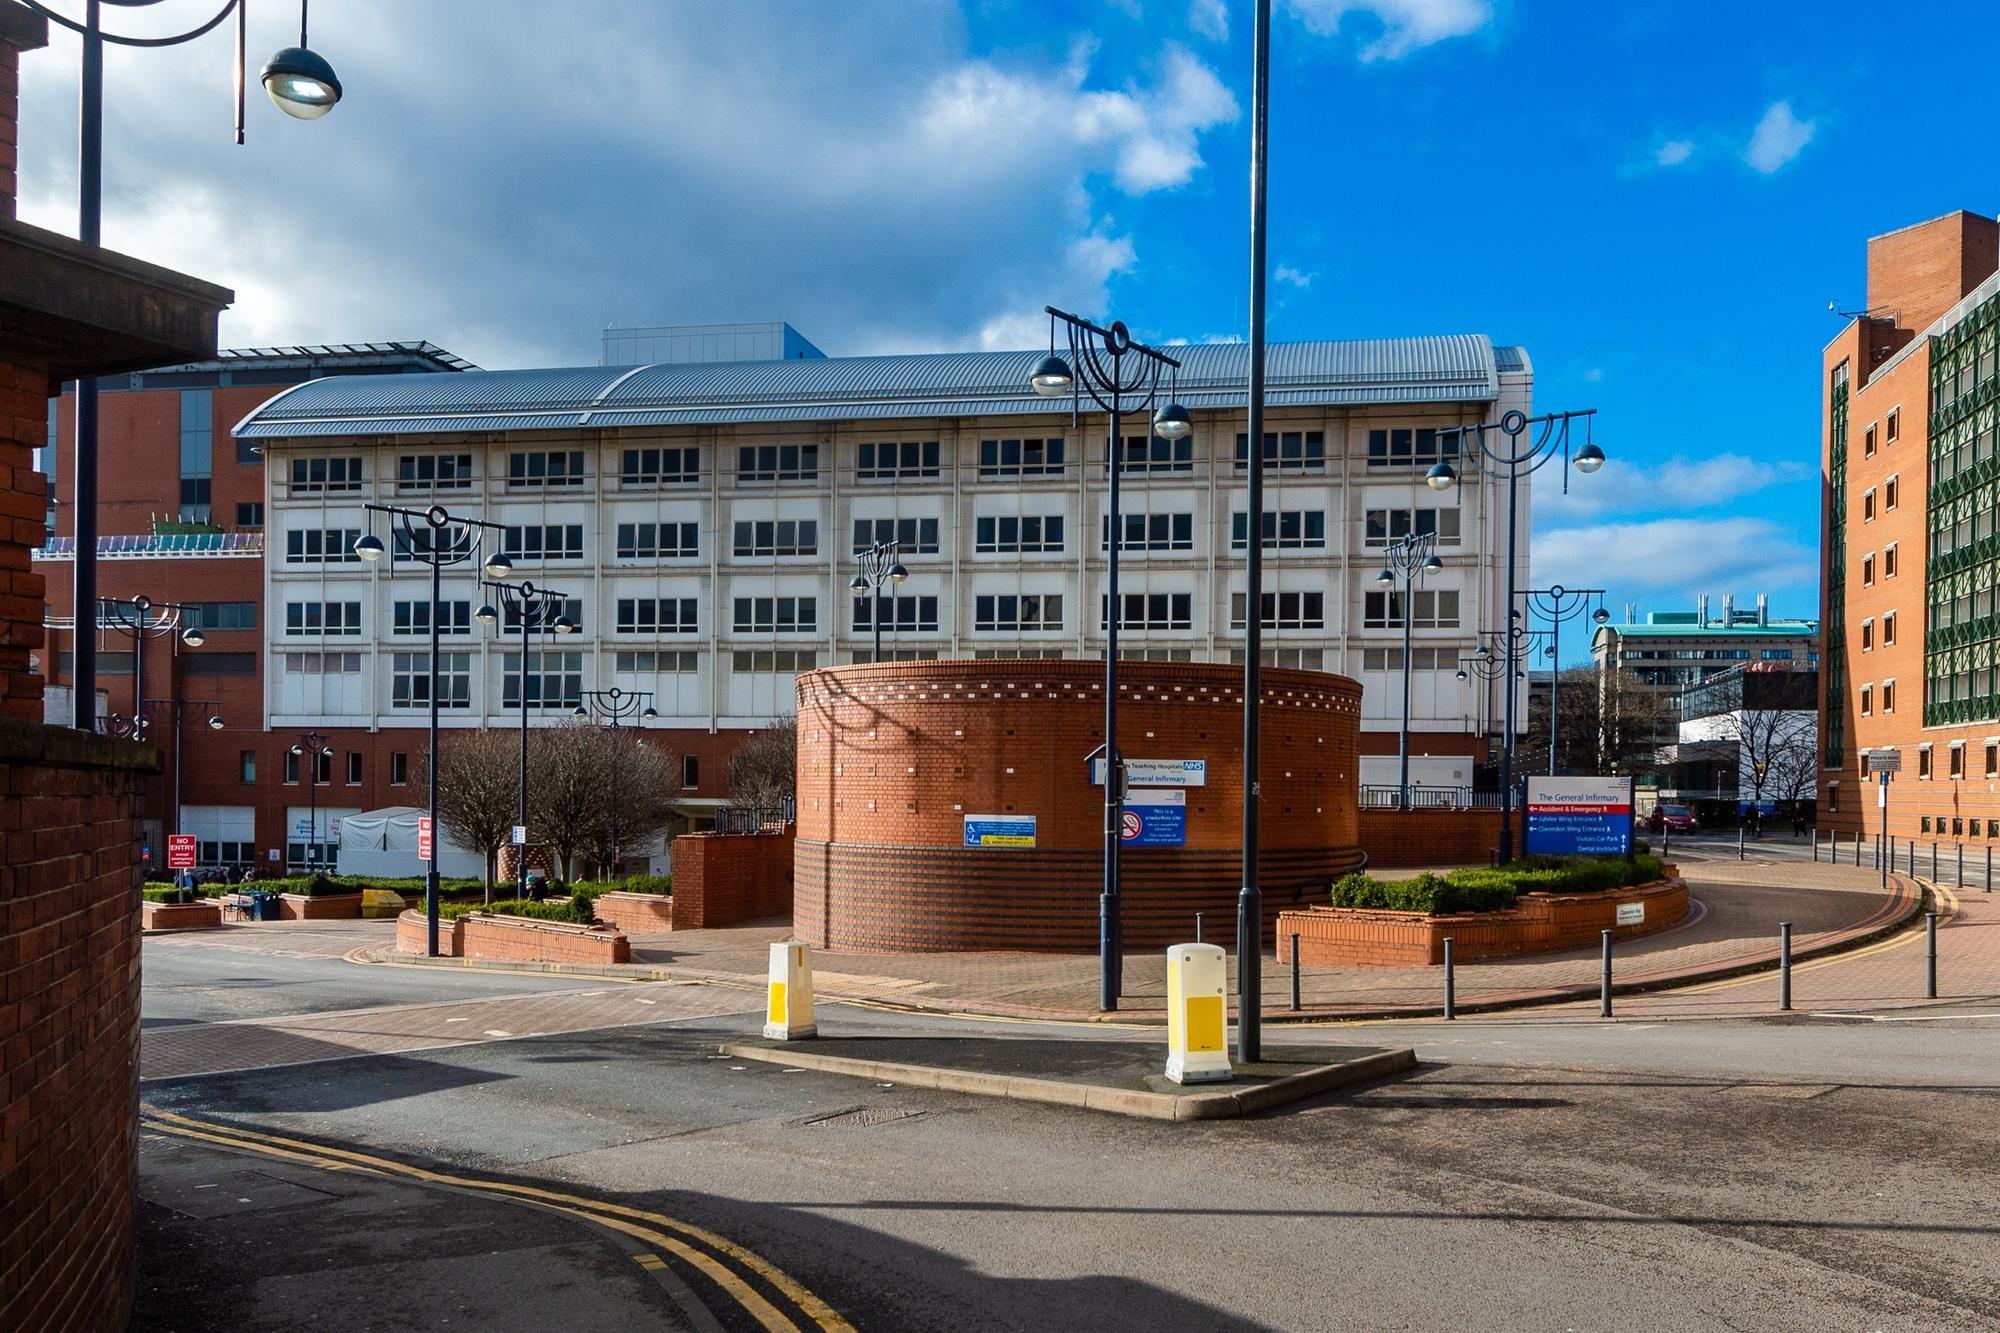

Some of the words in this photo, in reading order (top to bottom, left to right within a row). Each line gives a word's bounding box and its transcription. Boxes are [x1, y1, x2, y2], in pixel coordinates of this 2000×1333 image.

[1184, 762, 1203, 770] NHS
[1155, 775, 1186, 785] Infirmary
[1539, 793, 1553, 801] The
[1554, 793, 1584, 801] General
[1585, 793, 1619, 803] Infirmary
